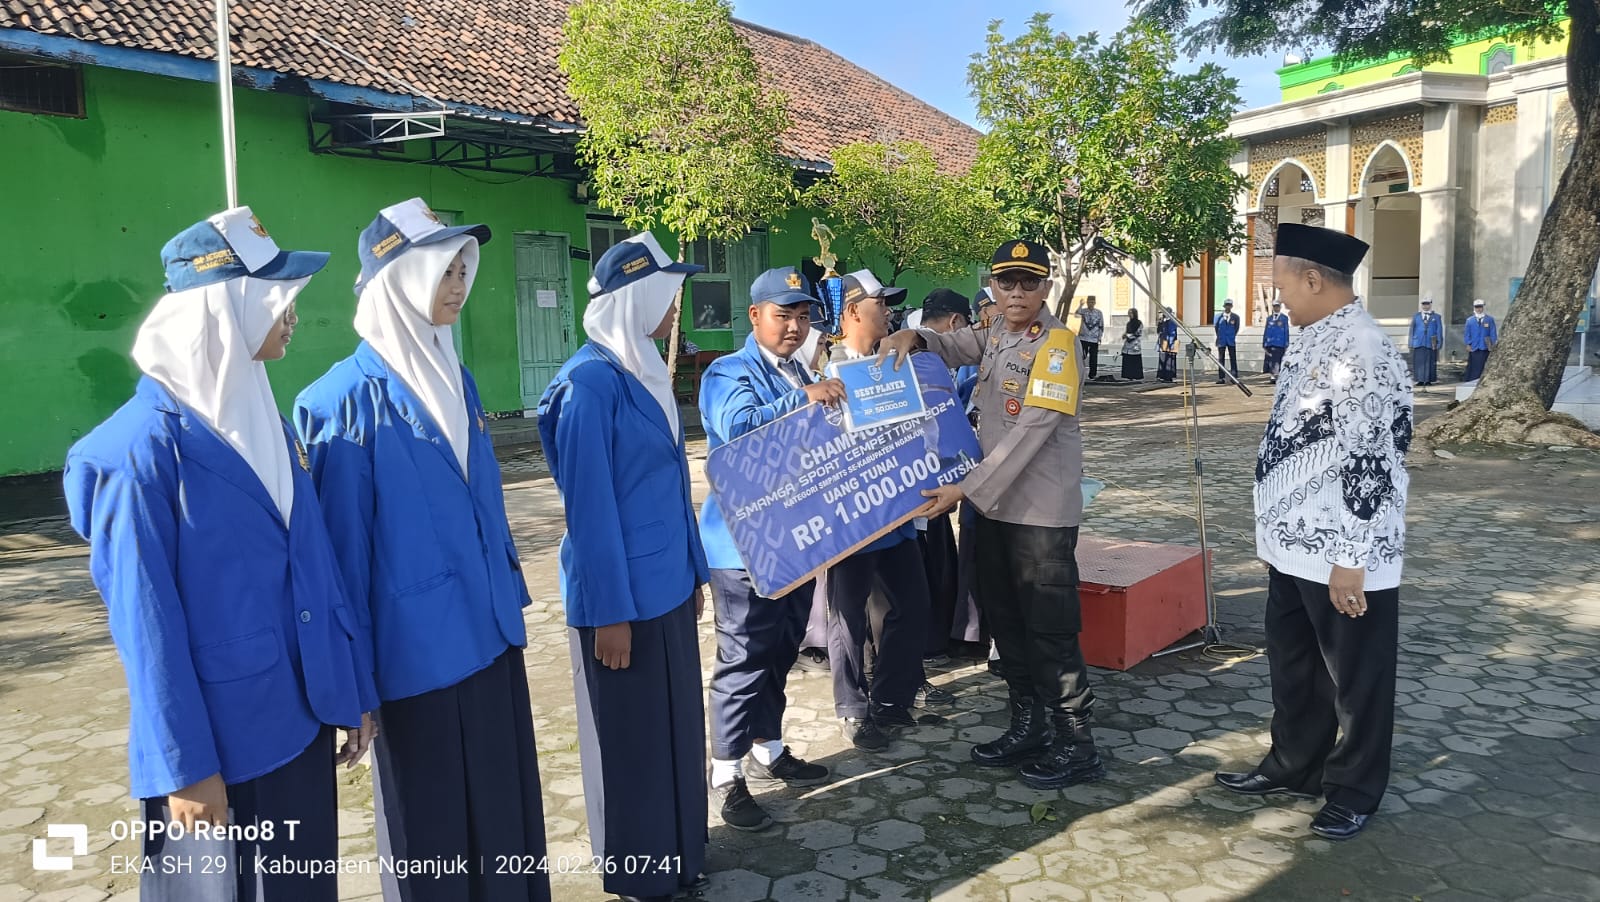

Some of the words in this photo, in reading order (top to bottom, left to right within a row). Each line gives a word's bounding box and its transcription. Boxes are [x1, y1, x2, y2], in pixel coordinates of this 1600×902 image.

[854, 385, 874, 398] BEST
[875, 380, 906, 395] PLAYER
[735, 483, 797, 520] SMAMGA
[798, 458, 840, 487] SPORT
[845, 417, 921, 462] CEMPETTION
[924, 397, 955, 420] 2024
[783, 485, 818, 508] KATEGORI
[818, 469, 848, 489] SMP/MTS
[848, 443, 895, 473] SE-KABUPATEN
[895, 428, 926, 449] NGANJUK
[801, 425, 889, 470] CHAMPIO
[822, 477, 860, 504] UANG
[860, 456, 899, 484] TUNAI
[936, 458, 980, 487] FUTSAL
[791, 515, 833, 551] RP.
[835, 452, 940, 525] 1.000.000
